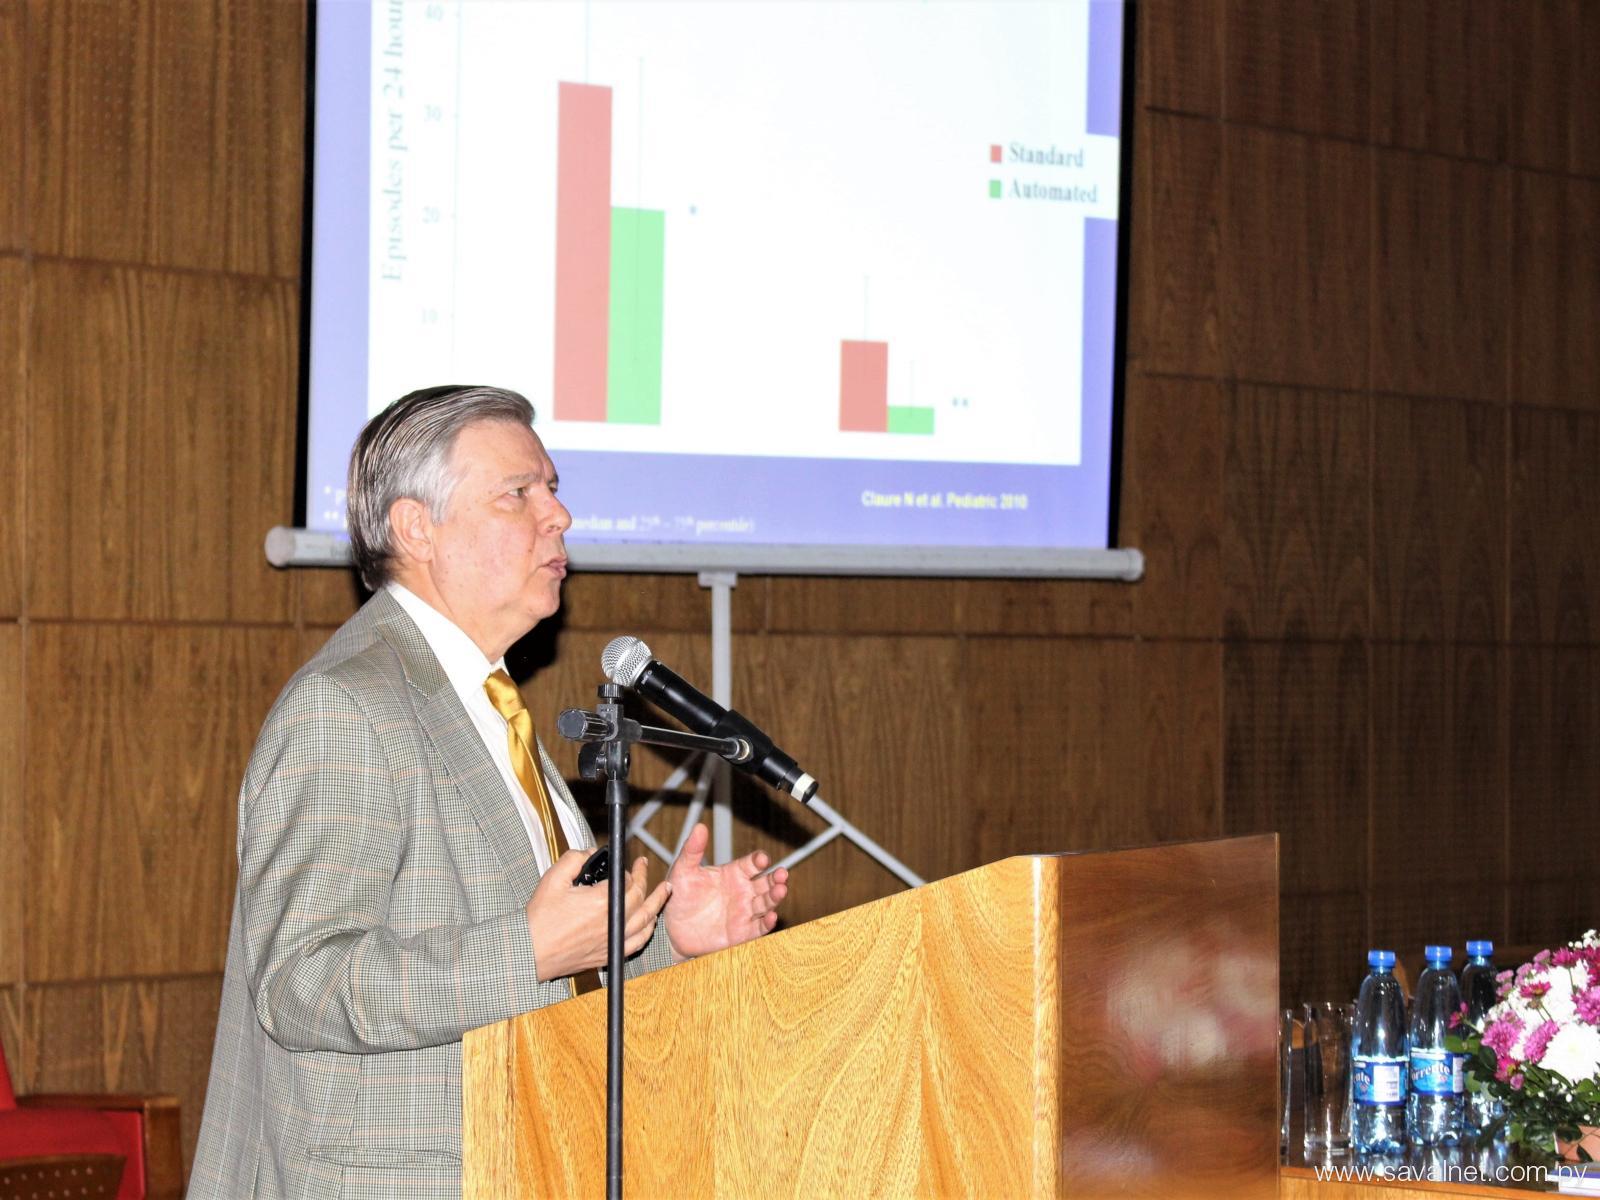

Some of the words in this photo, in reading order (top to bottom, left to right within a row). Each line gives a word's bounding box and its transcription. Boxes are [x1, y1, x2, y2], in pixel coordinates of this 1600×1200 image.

[382, 67, 403, 99] 24
[388, 111, 407, 152] per
[1009, 143, 1084, 168] Standard
[1009, 179, 1097, 203] Automated
[381, 159, 407, 282] Episodes
